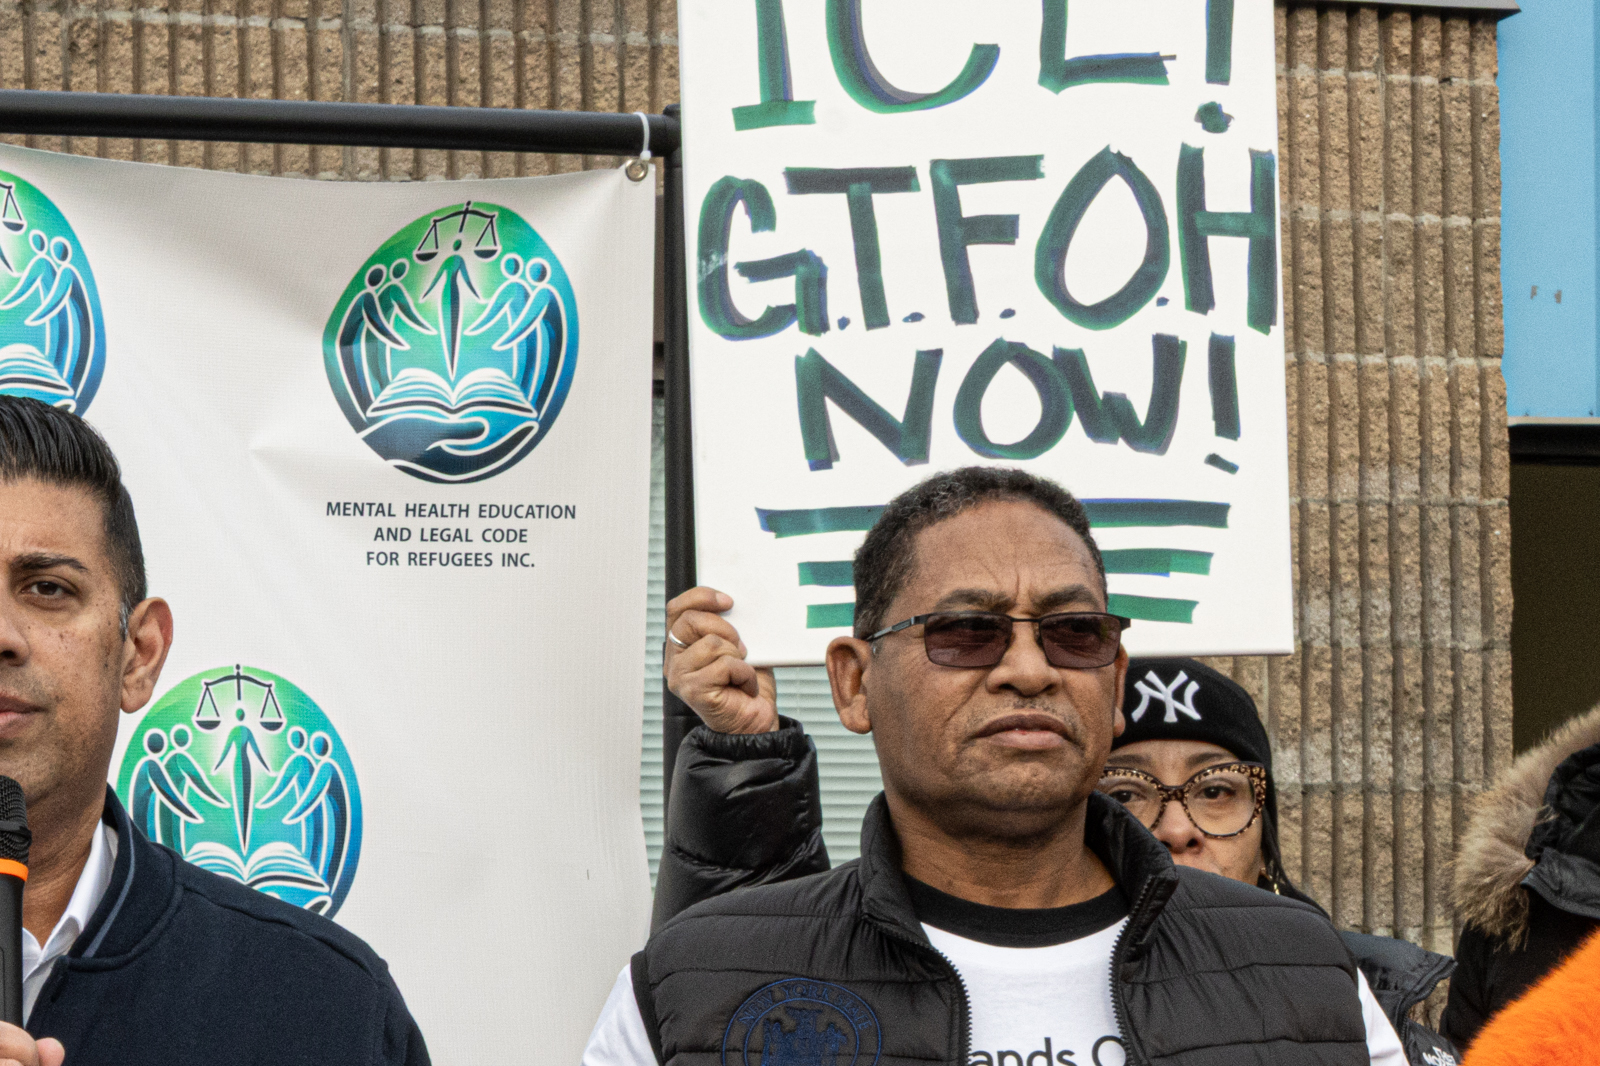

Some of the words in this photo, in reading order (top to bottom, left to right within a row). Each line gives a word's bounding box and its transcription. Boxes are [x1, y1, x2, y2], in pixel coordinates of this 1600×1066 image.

[795, 331, 1241, 474] NOW!
[327, 502, 396, 517] MENTAL
[406, 504, 469, 517] HEALTH
[479, 504, 575, 519] EDUCATION
[374, 528, 411, 541] AND
[421, 528, 473, 542] LEGAL
[482, 529, 527, 542] CODE
[367, 552, 399, 565] FOR
[408, 552, 492, 566] REFUGEES
[502, 553, 534, 567] INC.
[739, 991, 774, 1025] NEW
[782, 984, 833, 1001] YORK
[837, 994, 872, 1031] STATE
